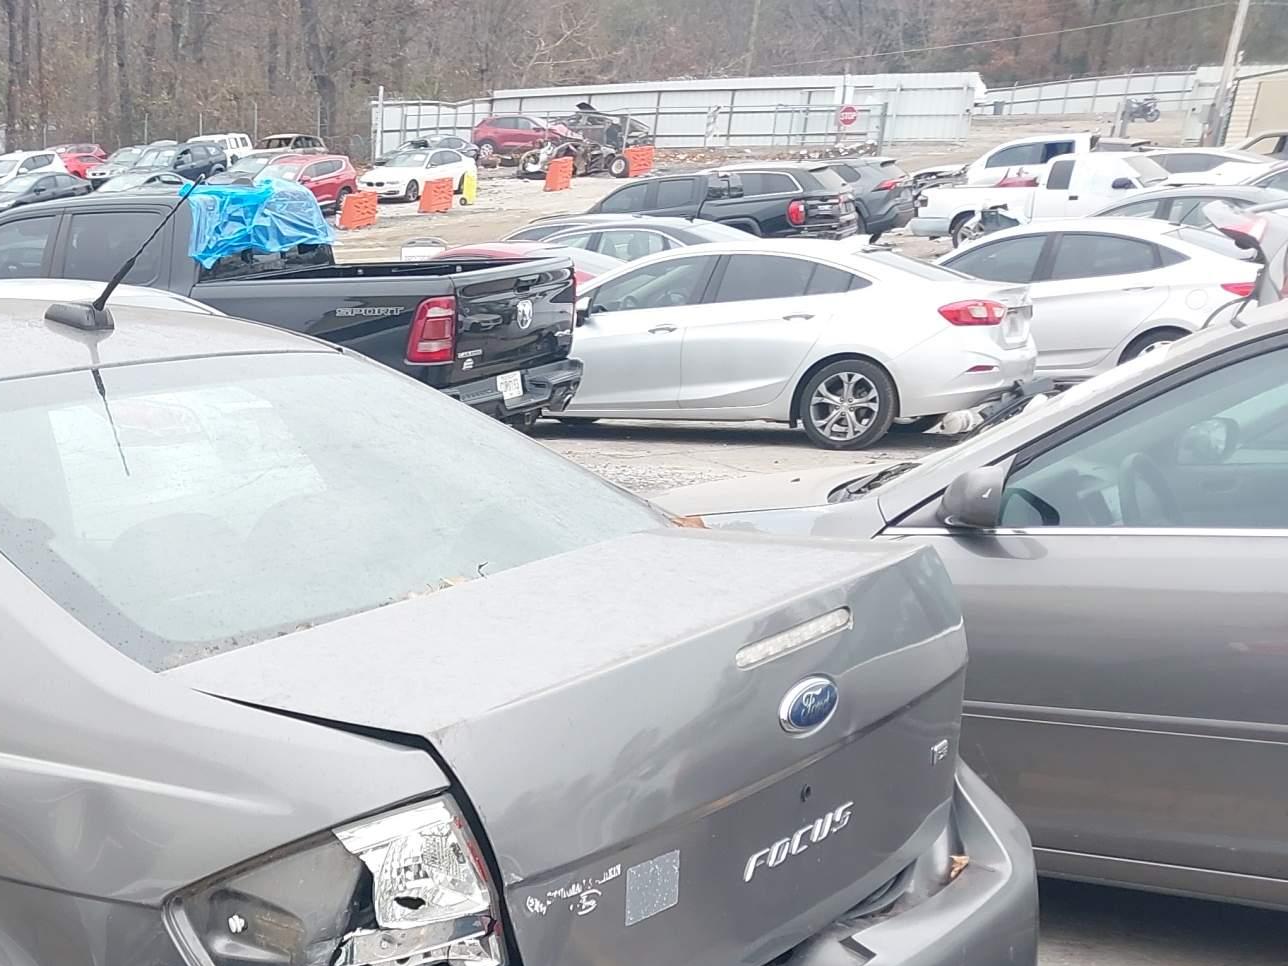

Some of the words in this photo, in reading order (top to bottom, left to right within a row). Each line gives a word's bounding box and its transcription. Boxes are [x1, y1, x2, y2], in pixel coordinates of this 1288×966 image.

[839, 111, 857, 121] STOP
[335, 306, 405, 317] SPORT
[743, 801, 855, 883] FOCUS
